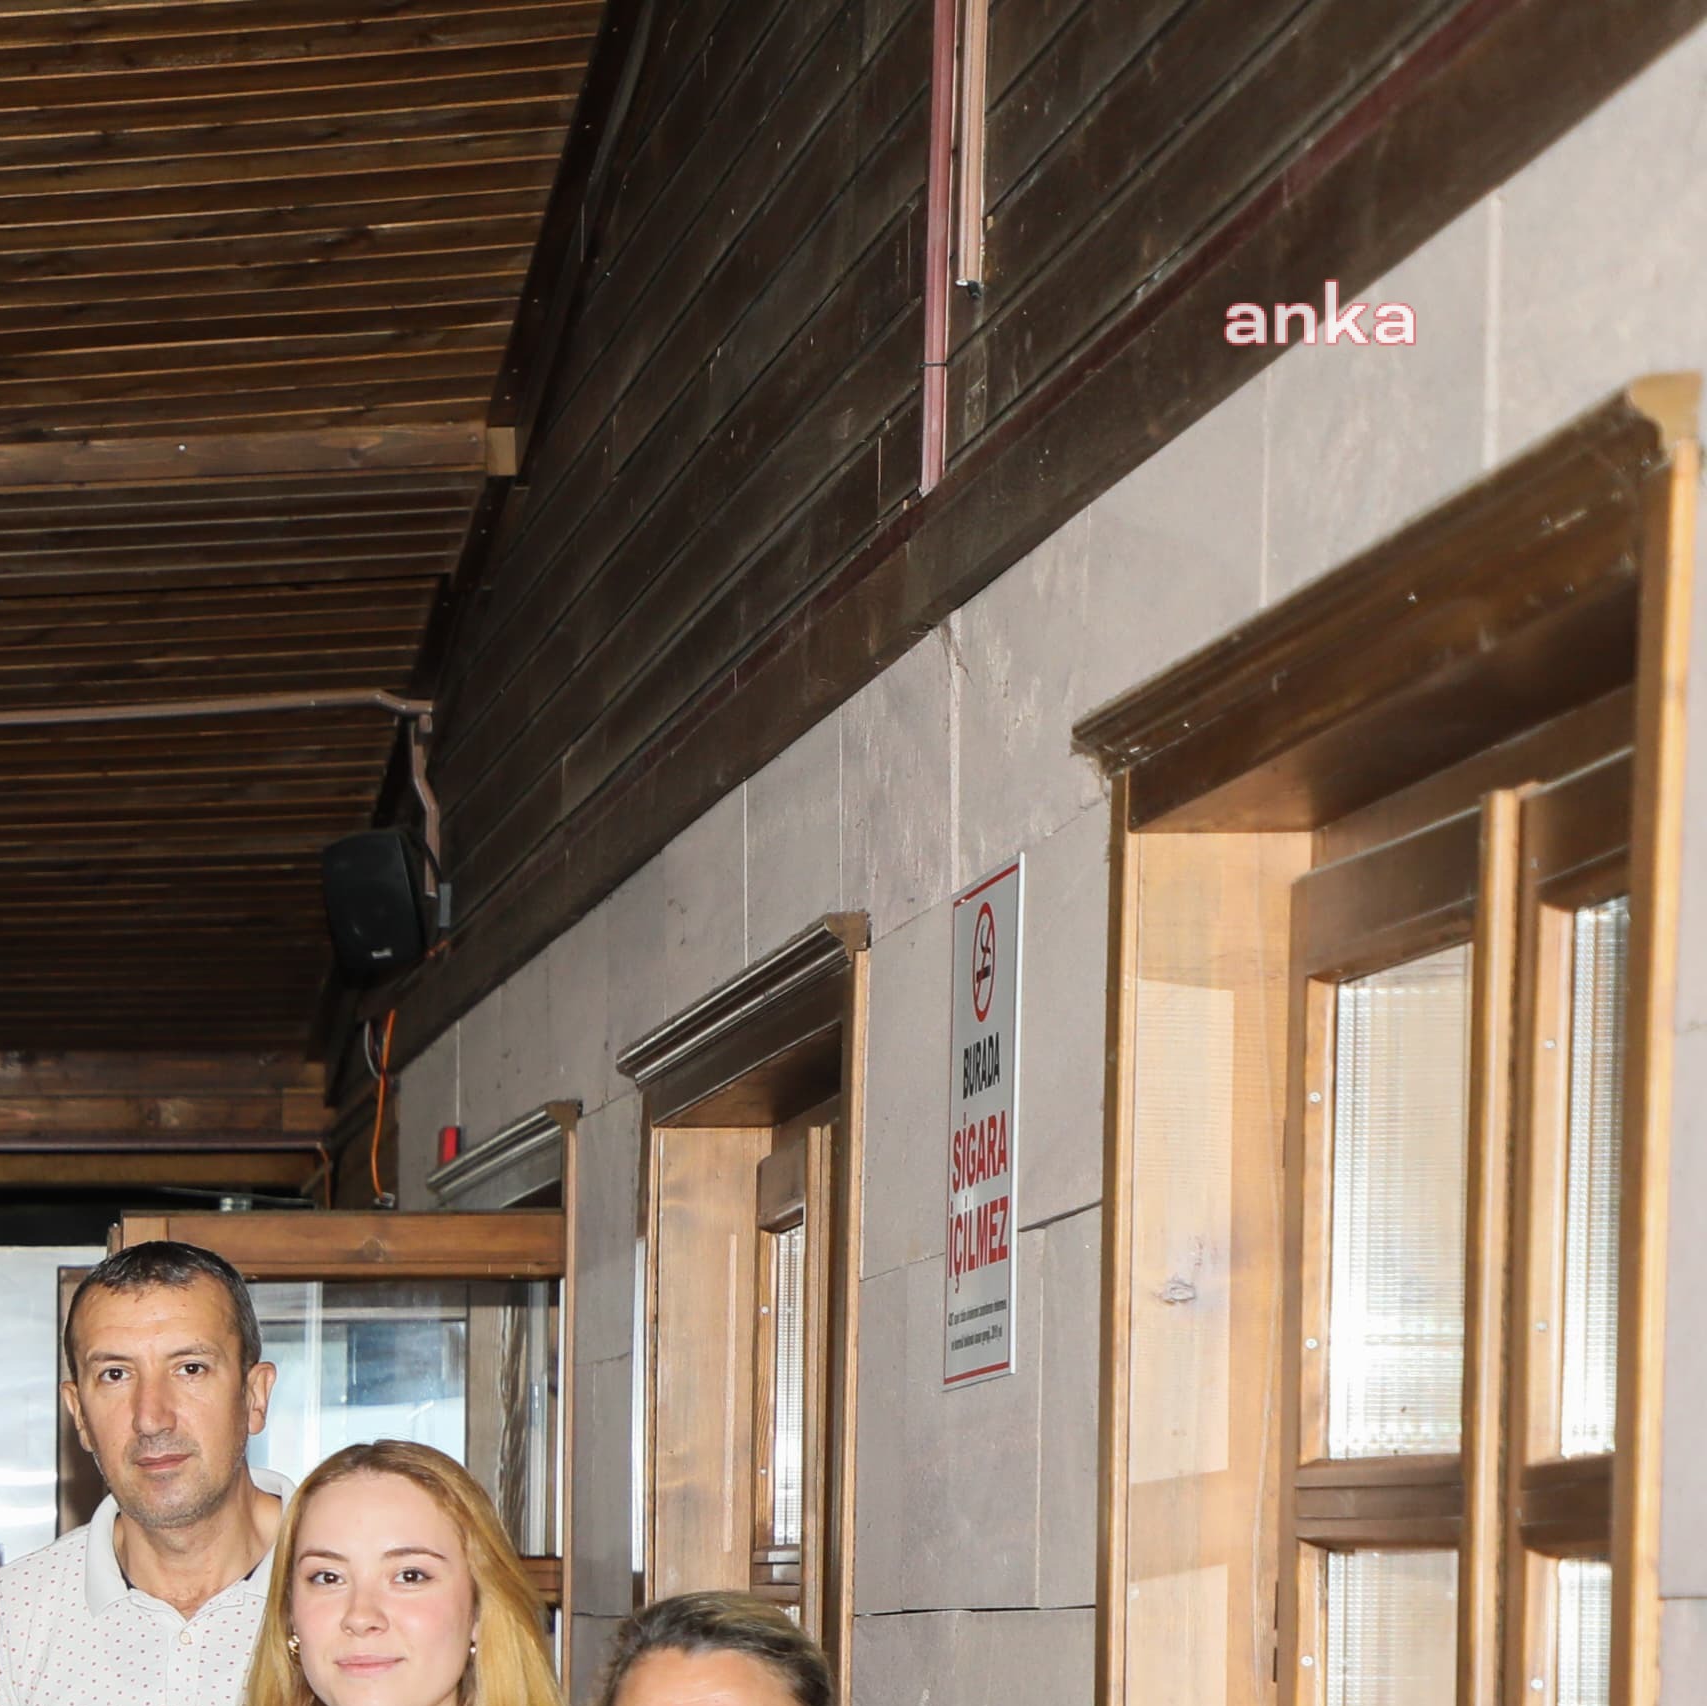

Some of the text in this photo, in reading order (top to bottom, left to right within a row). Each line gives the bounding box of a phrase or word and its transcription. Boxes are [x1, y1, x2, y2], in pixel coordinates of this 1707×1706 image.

[962, 1031, 1000, 1100] BURADA
[952, 1110, 1008, 1194] SİGARA
[948, 1195, 1009, 1293] İÇİLMEZ
